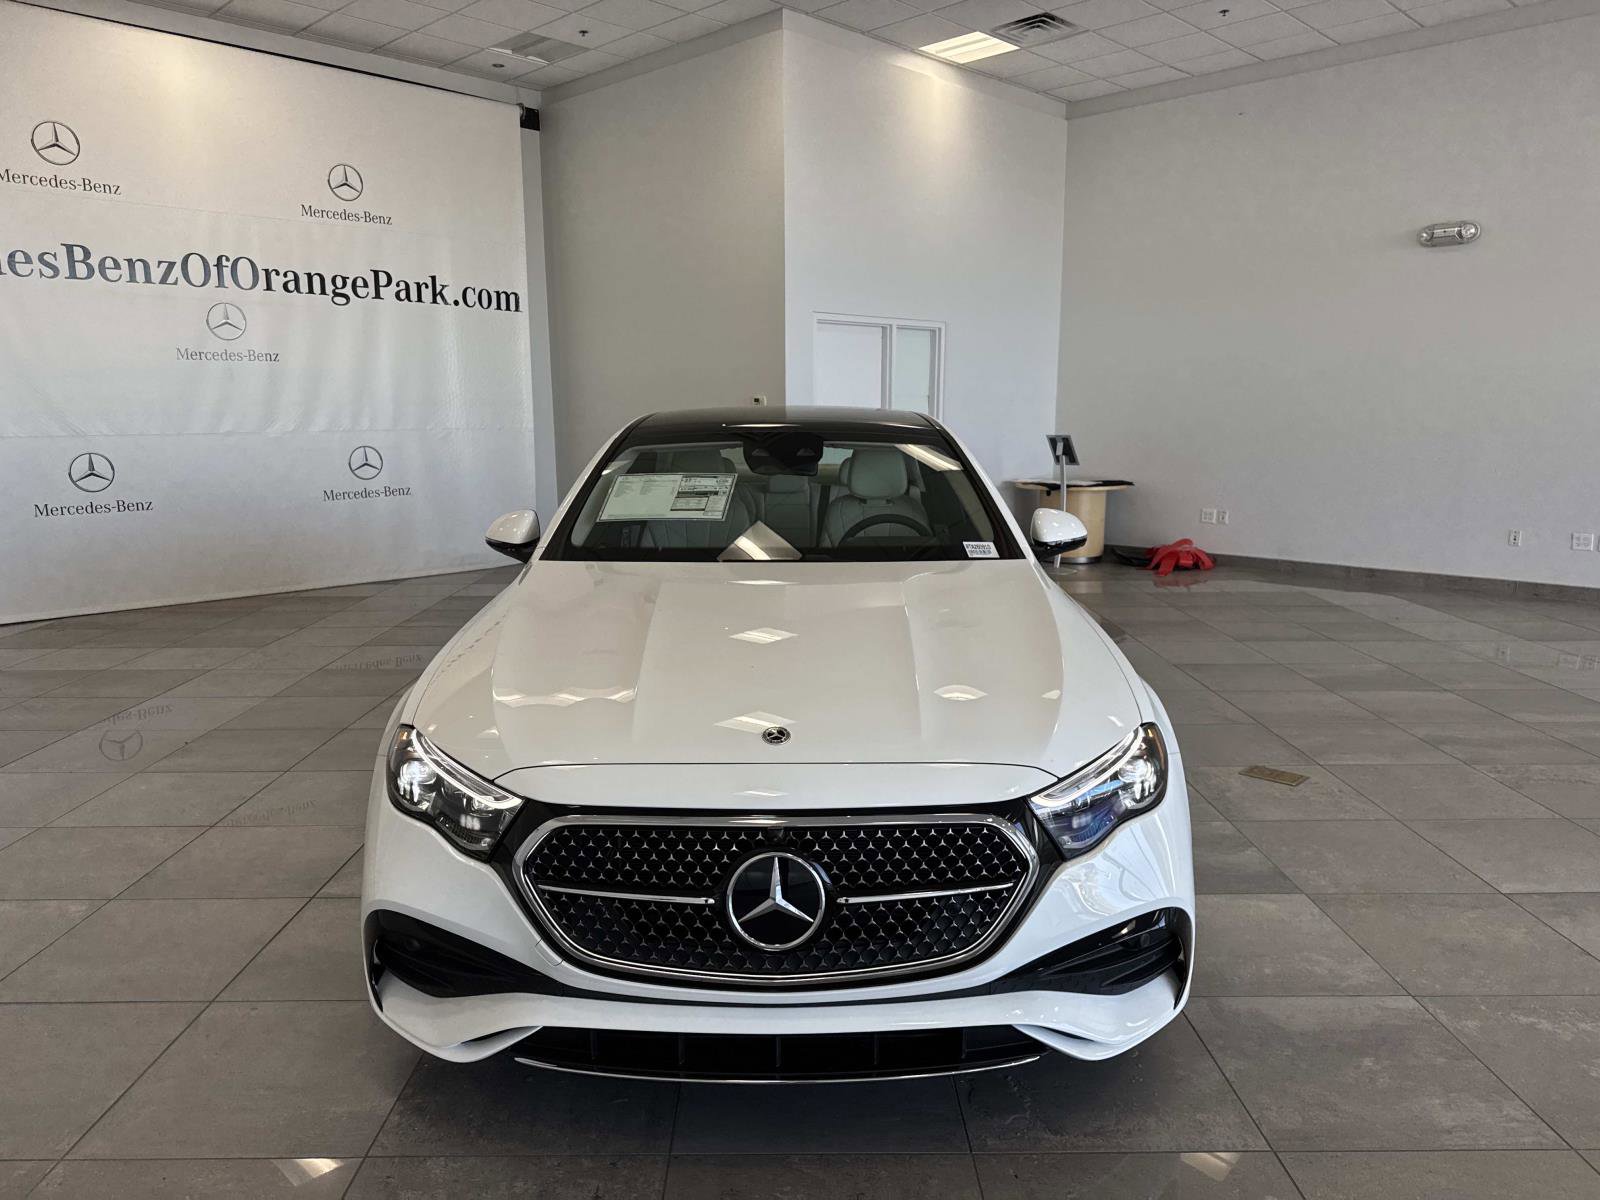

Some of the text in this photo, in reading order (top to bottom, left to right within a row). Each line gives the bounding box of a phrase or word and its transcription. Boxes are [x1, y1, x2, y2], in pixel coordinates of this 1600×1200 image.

[0, 168, 121, 195] Mercedes-Benz
[302, 205, 392, 224] Mercedes-Benz
[176, 348, 280, 363] Mercedes-Benz
[322, 486, 412, 502] Mercedes-Benz
[33, 500, 154, 517] Mercedes-Benz
